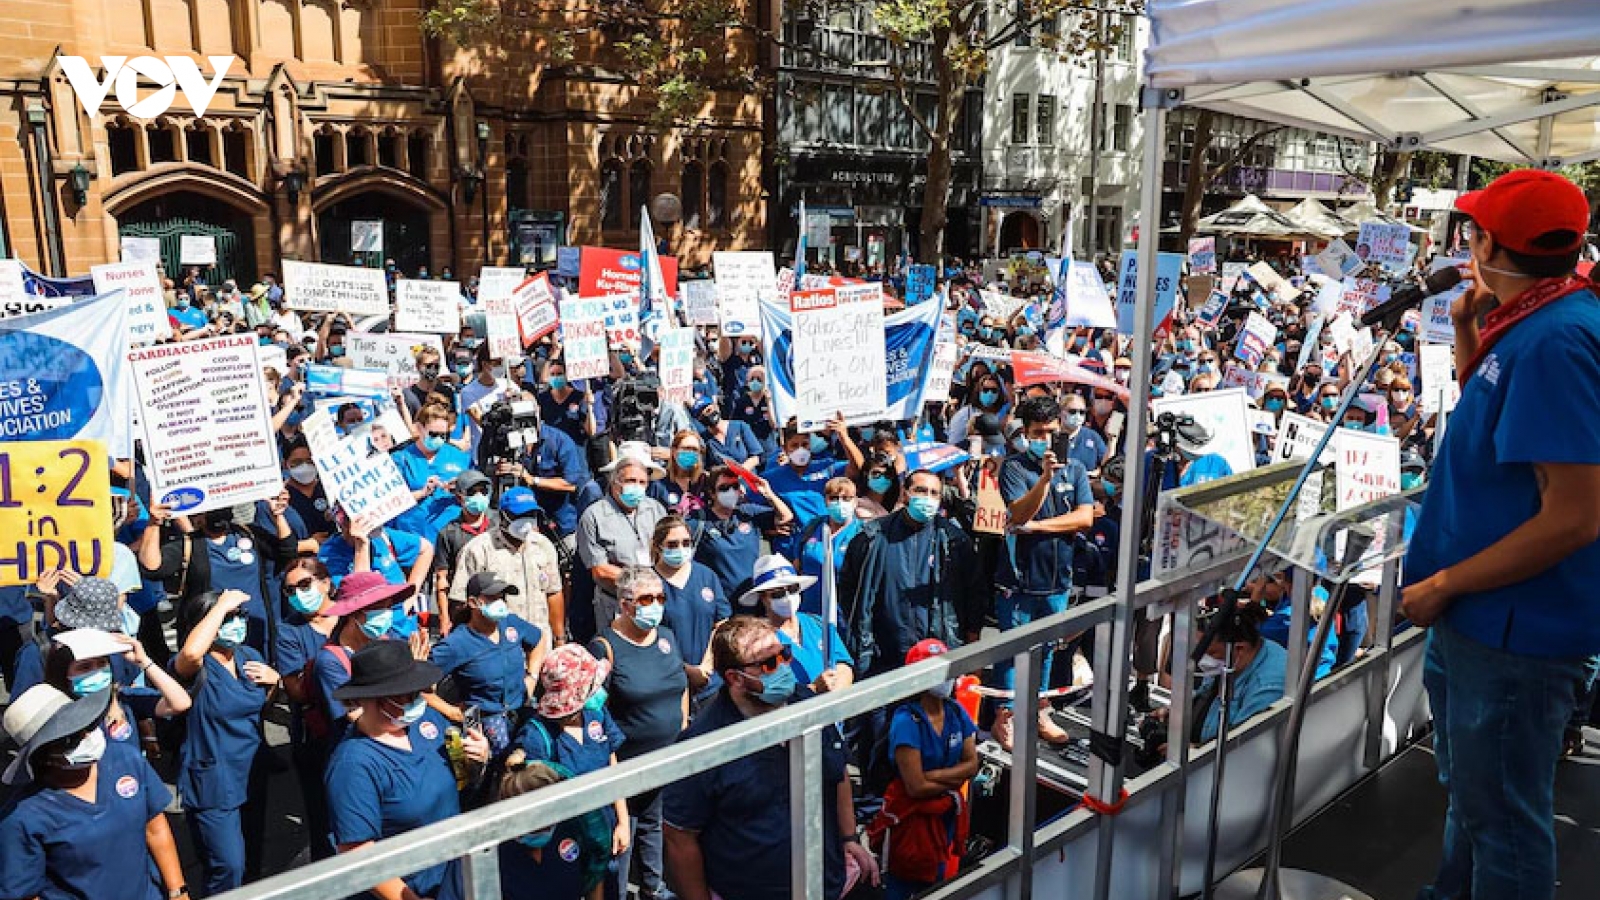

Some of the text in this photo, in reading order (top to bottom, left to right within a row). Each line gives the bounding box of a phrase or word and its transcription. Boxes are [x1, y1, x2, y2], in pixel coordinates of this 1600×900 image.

[832, 171, 895, 183] AGRICULTURE
[106, 269, 145, 281] Nurses
[601, 268, 640, 282] Hornsb
[129, 287, 154, 297] one
[793, 292, 835, 310] Ratios
[212, 354, 240, 364] COVID
[145, 359, 181, 378] FOLLOW
[27, 377, 42, 394] &
[151, 375, 192, 396] STAFFING
[157, 399, 202, 411] OVERTIME
[176, 408, 195, 418] NOT
[0, 448, 94, 508] 1:2
[161, 466, 178, 476] THE
[27, 510, 60, 537] in
[0, 538, 102, 580] HDU
